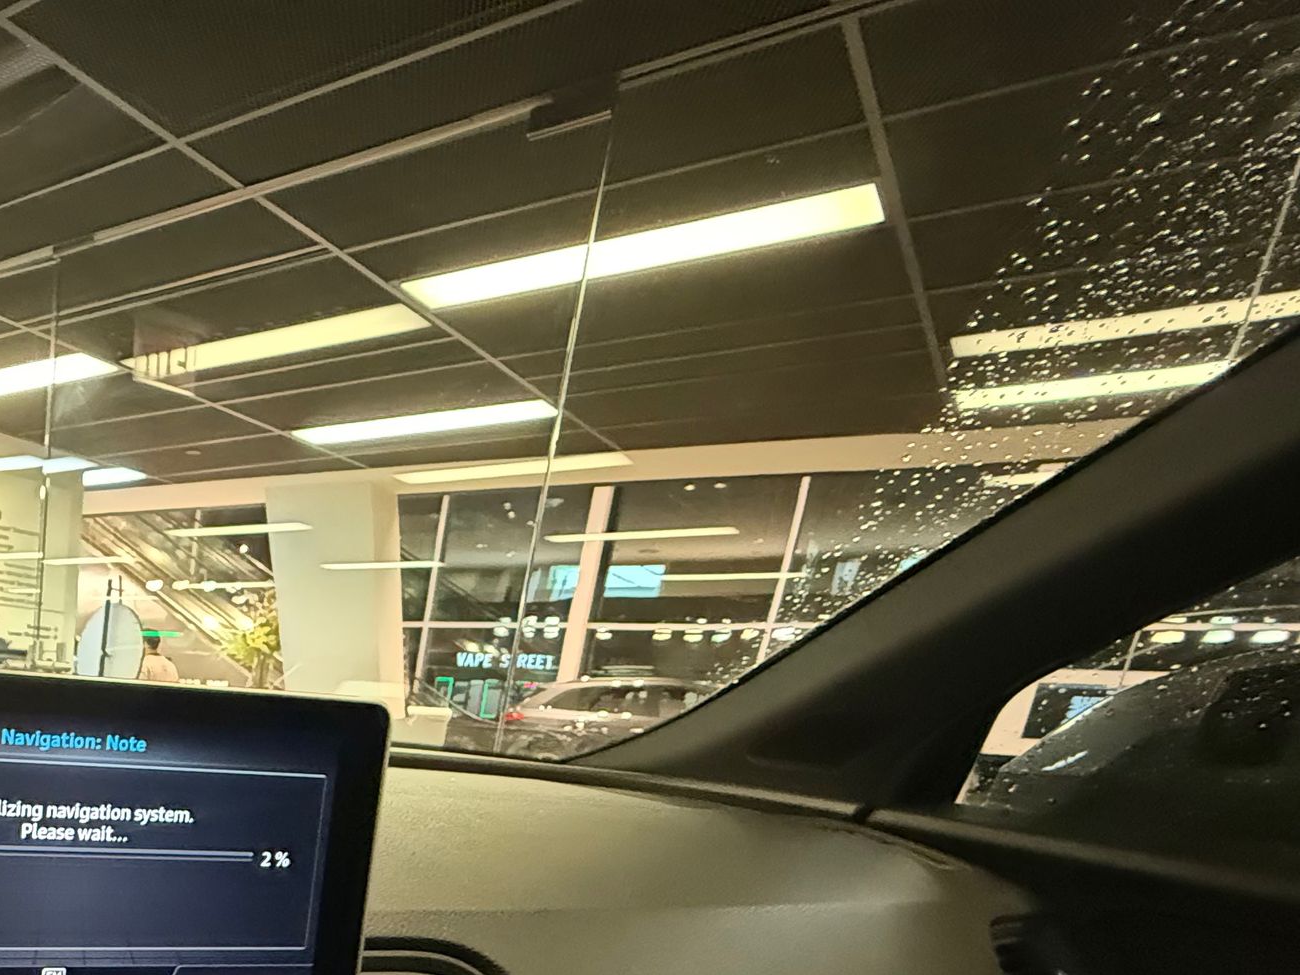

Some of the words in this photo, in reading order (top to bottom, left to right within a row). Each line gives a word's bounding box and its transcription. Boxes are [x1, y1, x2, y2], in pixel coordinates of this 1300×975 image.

[456, 652, 494, 668] VAPE
[1, 728, 102, 751] Navigation:
[105, 734, 148, 753] Note
[46, 803, 132, 824] navigation
[134, 806, 195, 826] system.
[20, 822, 75, 841] Please
[78, 825, 128, 843] wait...
